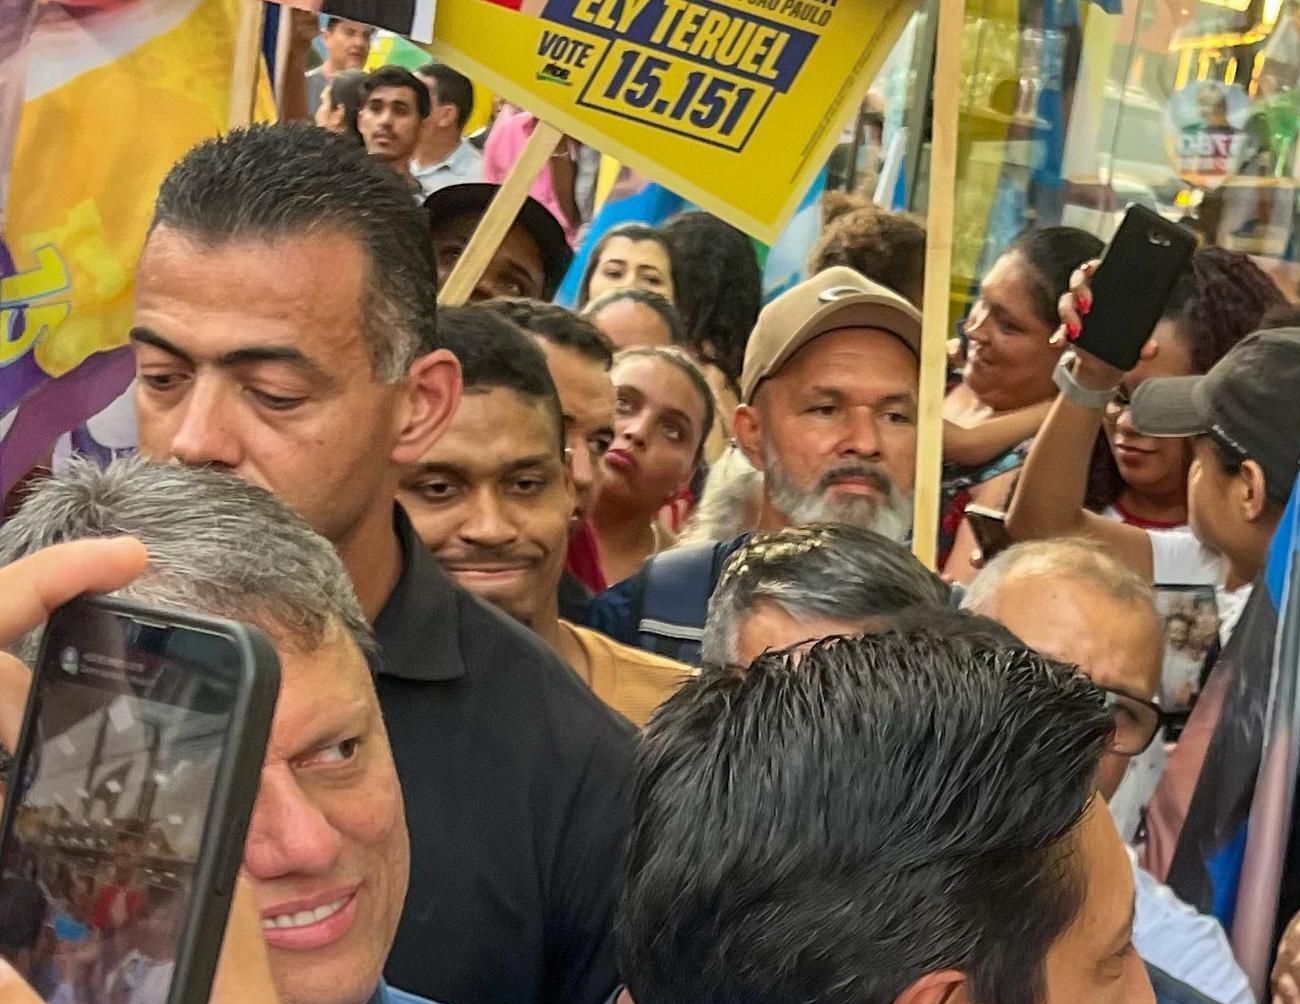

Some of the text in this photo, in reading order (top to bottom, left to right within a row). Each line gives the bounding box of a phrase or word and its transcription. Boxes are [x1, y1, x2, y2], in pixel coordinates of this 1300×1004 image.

[648, 0, 791, 80] TERUEL
[779, 0, 833, 27] PAULO
[537, 30, 596, 68] VOTE
[603, 49, 757, 137] 15.151
